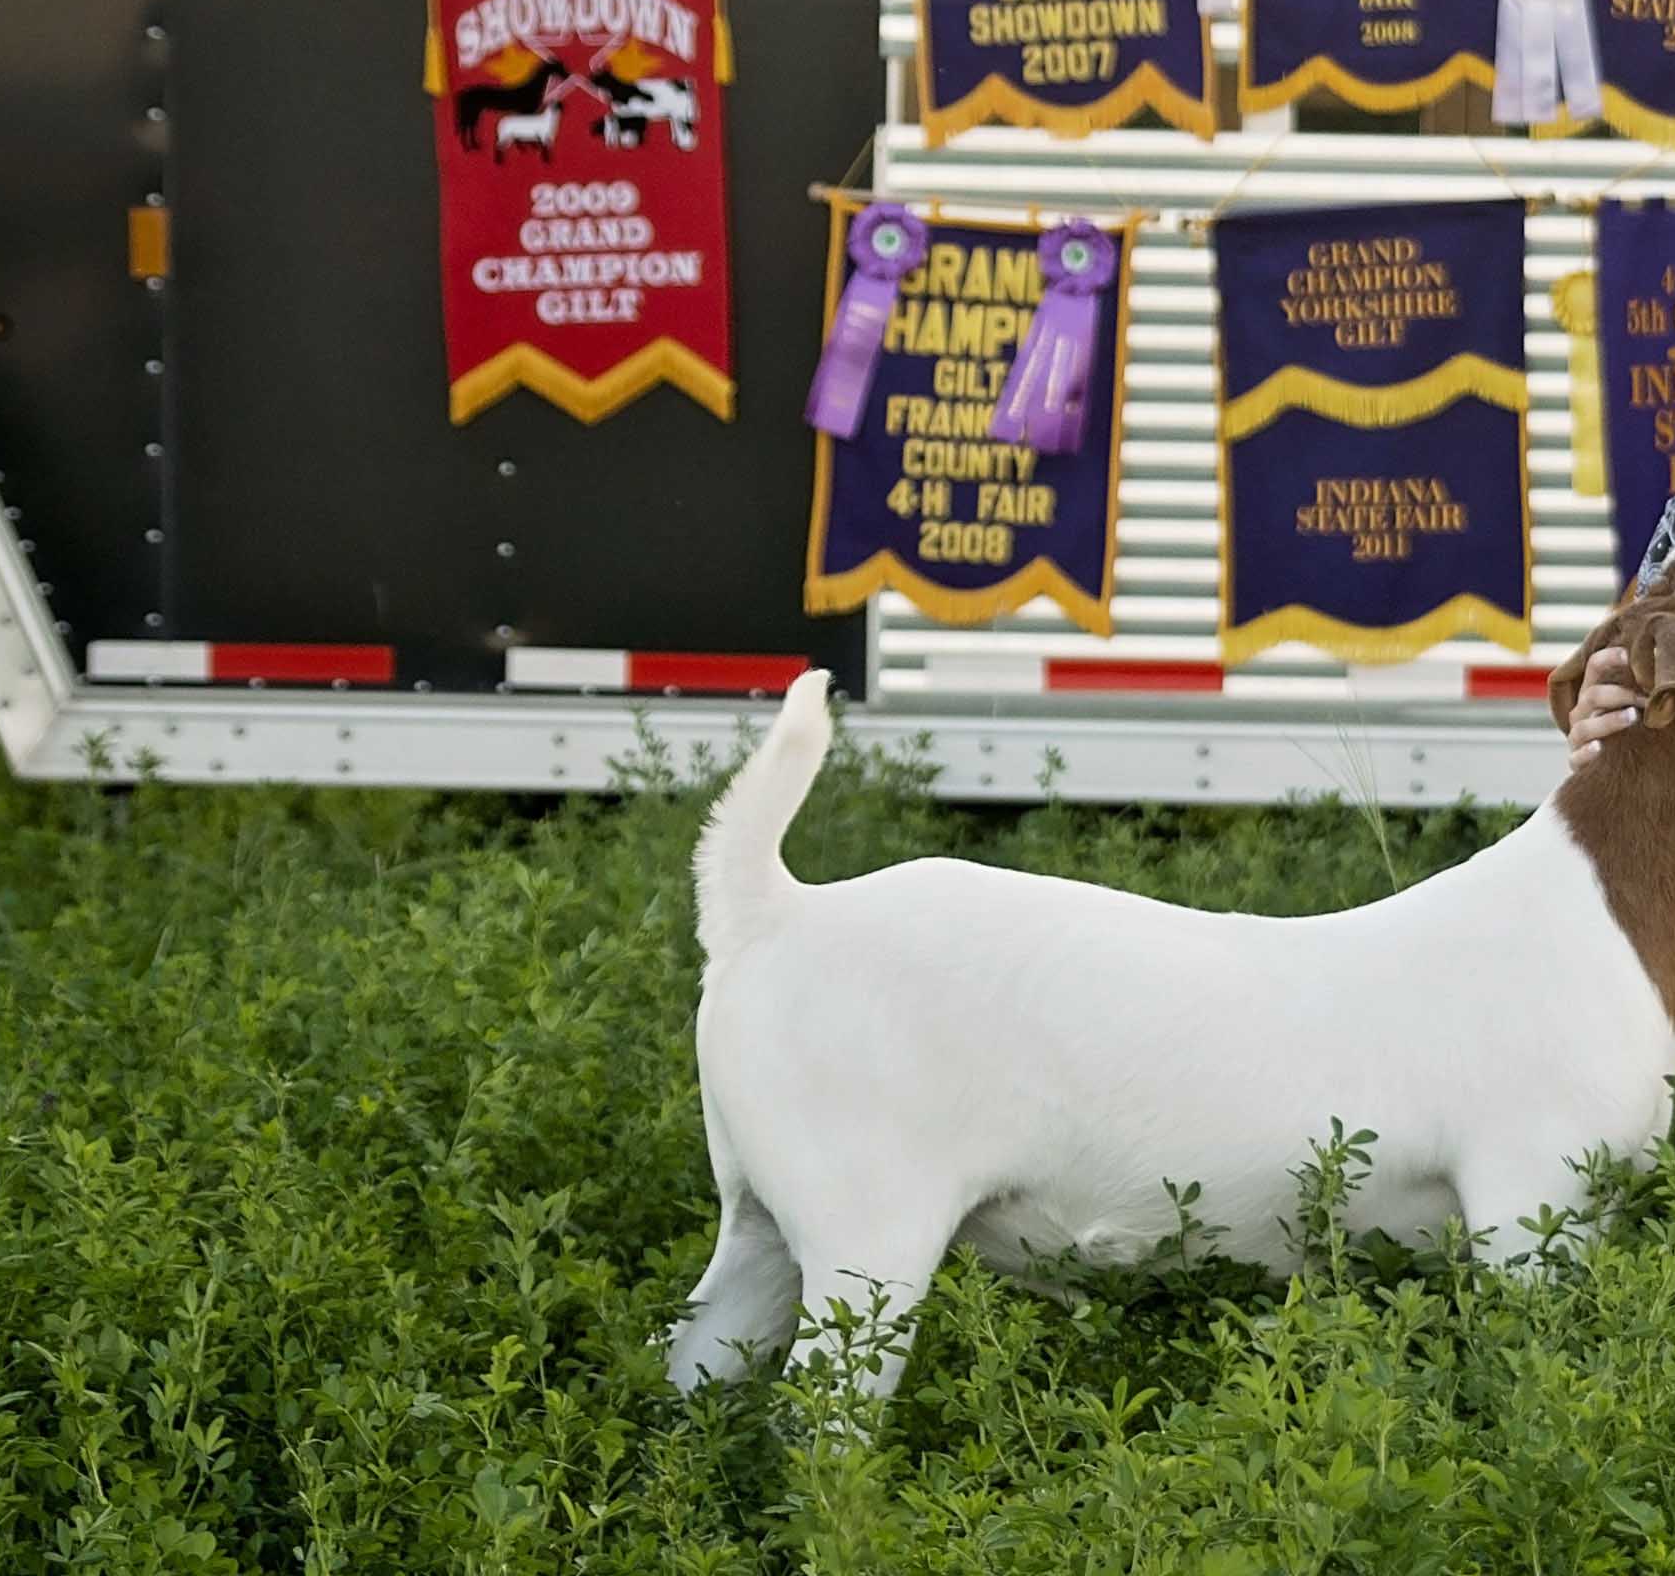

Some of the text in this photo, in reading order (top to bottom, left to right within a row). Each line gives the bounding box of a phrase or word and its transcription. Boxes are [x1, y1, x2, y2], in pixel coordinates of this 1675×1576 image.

[1360, 20, 1418, 47] 2008
[1022, 40, 1118, 85] 2007
[530, 181, 640, 217] 2009
[520, 218, 653, 251] GRAND
[1308, 238, 1419, 267] GRAND
[472, 251, 703, 292] CHAMPION
[1287, 263, 1446, 297] CHAMPION
[535, 289, 644, 323] GILT
[1279, 290, 1457, 323] YORKSHIRE
[1335, 320, 1406, 347] GILT
[934, 358, 1010, 399] GILT
[902, 440, 1038, 481] COUNTY
[886, 480, 1057, 523] 4-H FAIR
[1315, 479, 1447, 505] INDIANA
[1295, 504, 1467, 533] STATE FAIR
[918, 522, 1014, 564] 2008
[1351, 534, 1410, 562] 2011
